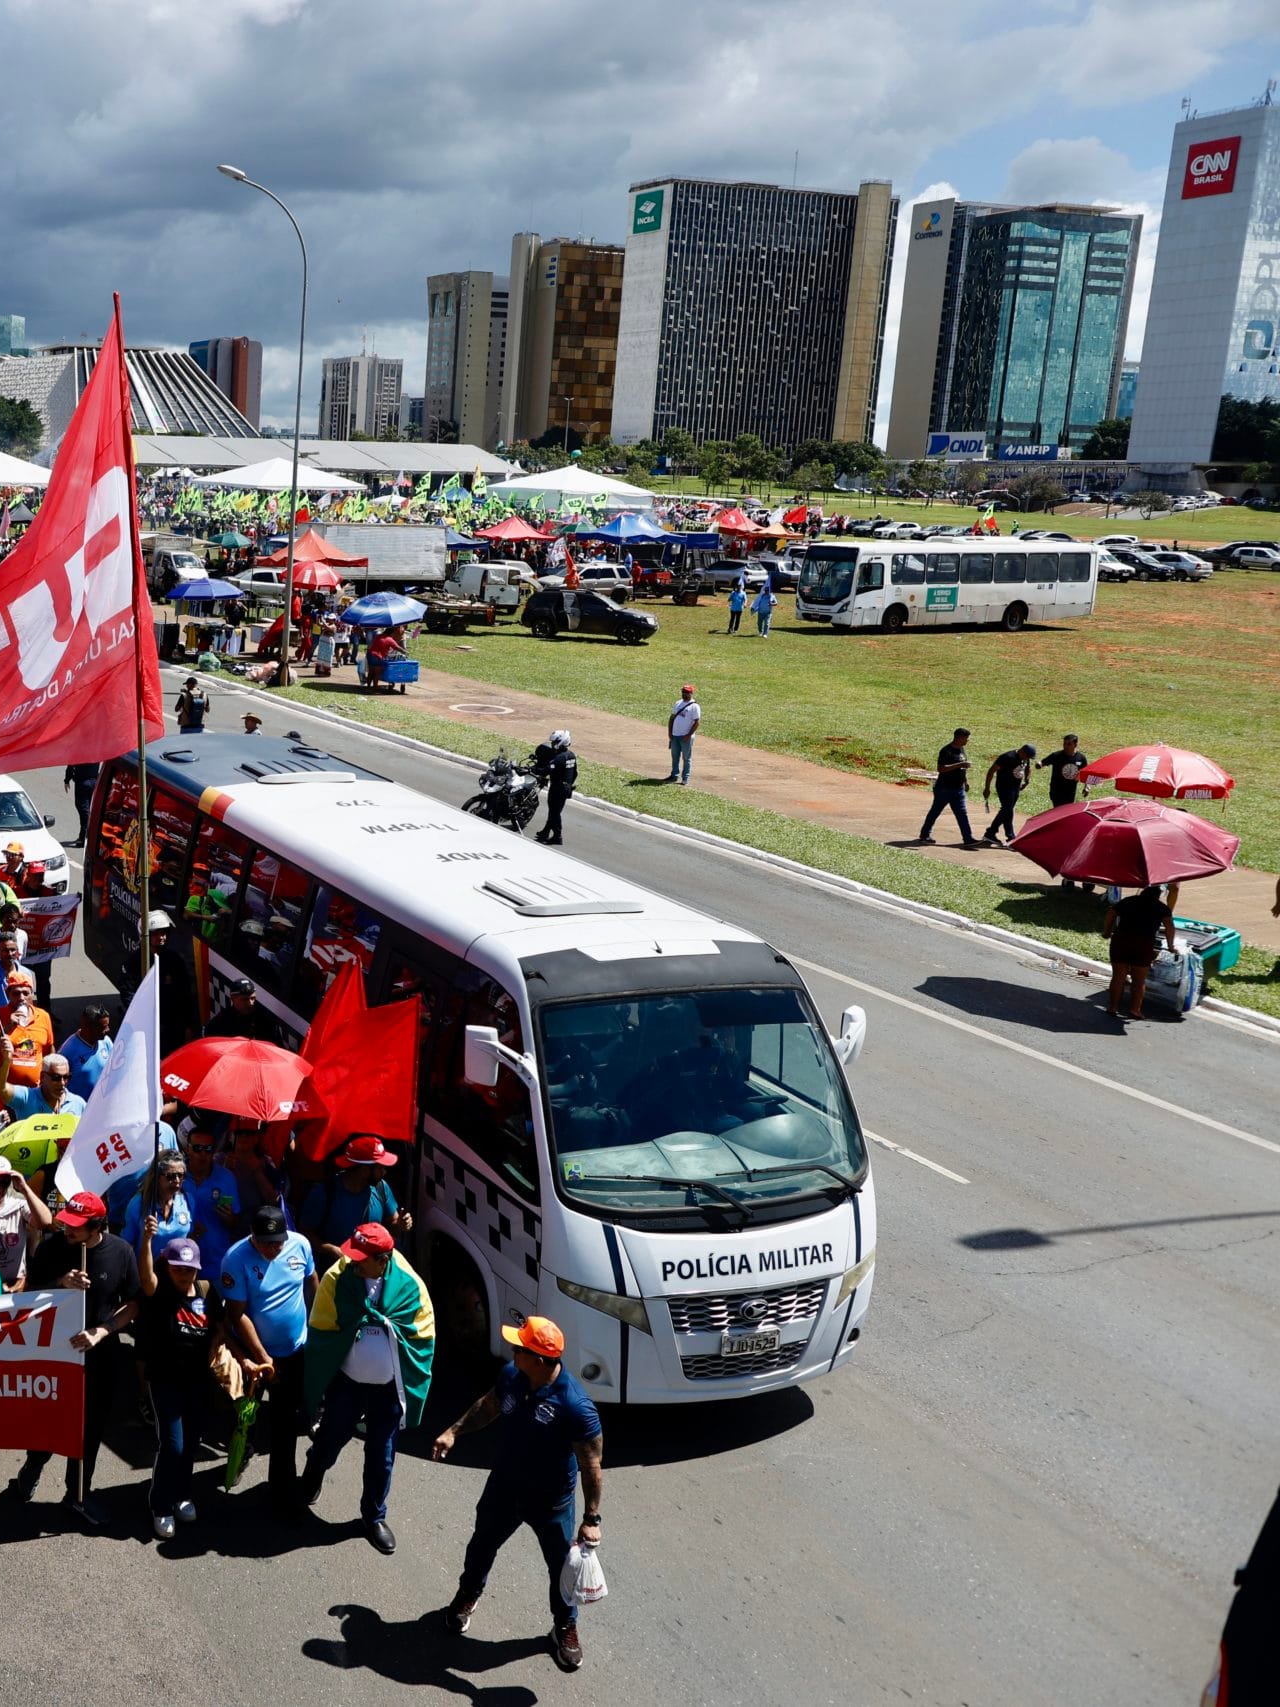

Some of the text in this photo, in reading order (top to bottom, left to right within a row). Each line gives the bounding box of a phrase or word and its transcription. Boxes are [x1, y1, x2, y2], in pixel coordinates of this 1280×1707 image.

[1190, 150, 1231, 175] CNN
[1193, 174, 1223, 185] BRASIL
[637, 215, 655, 225] INCRA
[949, 438, 984, 453] CNDL
[1016, 445, 1051, 457] ANFIP
[1184, 790, 1212, 799] BRAHMA
[335, 799, 381, 807] 379
[436, 852, 511, 863] PMDF
[662, 1243, 833, 1282] POLÍCIA MILITAR
